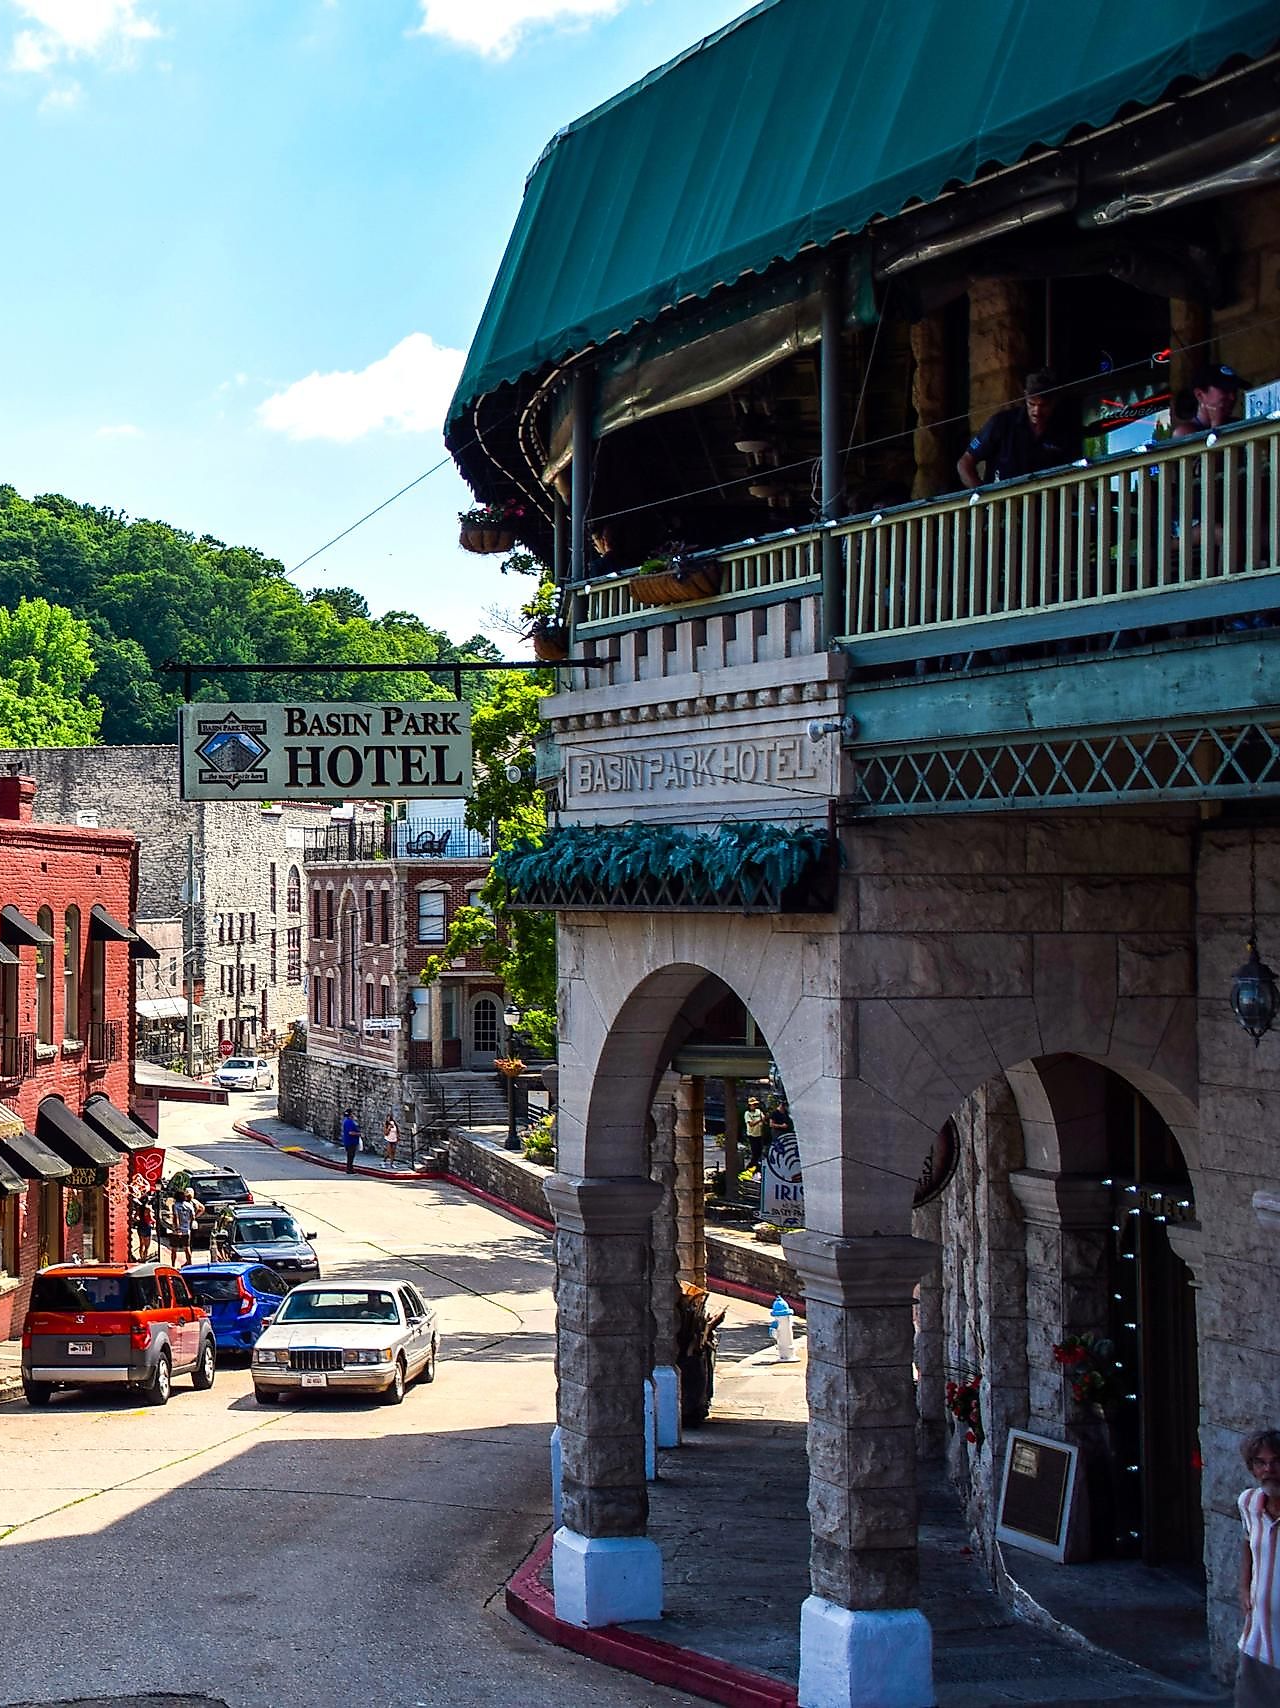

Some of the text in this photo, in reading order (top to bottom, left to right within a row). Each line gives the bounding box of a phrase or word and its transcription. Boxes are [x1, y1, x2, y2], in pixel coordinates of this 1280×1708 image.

[283, 706, 462, 737] BASIN PARK
[283, 744, 463, 788] HOTEL
[579, 739, 816, 793] BASIN PARK HOTEL
[65, 1175, 96, 1185] SHOP
[72, 1167, 97, 1177] OWN
